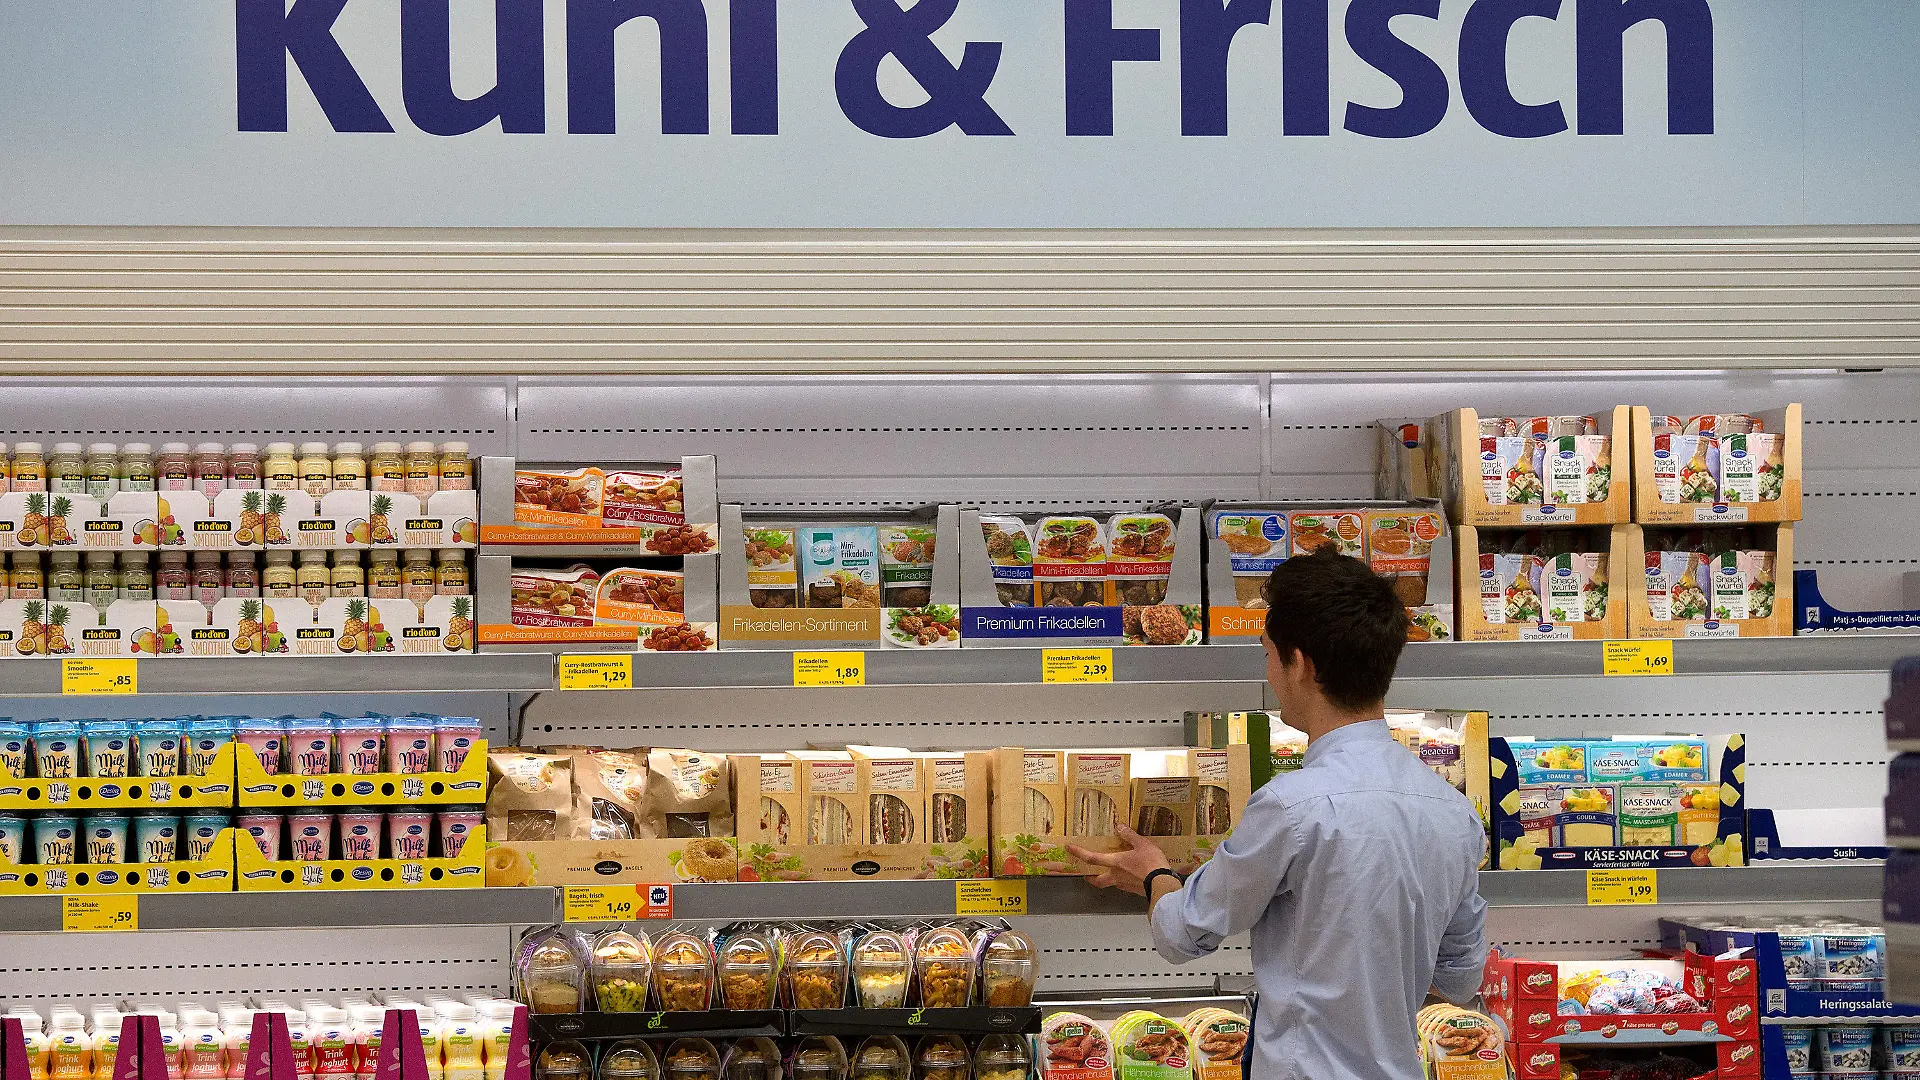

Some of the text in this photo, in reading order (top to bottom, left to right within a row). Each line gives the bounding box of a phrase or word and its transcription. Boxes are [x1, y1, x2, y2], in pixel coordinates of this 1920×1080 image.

[833, 0, 1017, 139] &
[1064, 0, 1715, 139] Frisch
[1726, 458, 1752, 466] Snack
[1525, 512, 1572, 522] Snackwürfel
[1698, 512, 1745, 521] Snackwürfel
[83, 533, 124, 547] SMOOTHIE
[193, 533, 233, 547] SMOOTHIE
[297, 532, 336, 547] SMOOTHIE
[404, 532, 443, 546] SMOOTHIE
[1114, 564, 1171, 574] Mini-Frikadelle
[1551, 575, 1578, 584] Snack
[1716, 574, 1743, 583] Snack
[733, 617, 868, 633] Frikadellen-Sortiment
[977, 615, 1105, 630] Premium Frikadellen
[81, 641, 121, 655] SMOOTHIE
[191, 641, 230, 655] SMOOTHIE
[296, 640, 336, 654] SMOOTHIE
[402, 639, 441, 653] SMOOTHIE
[1645, 656, 1668, 667] 1,69
[835, 667, 859, 679] 1,89
[1083, 665, 1107, 676] 2,39
[108, 675, 131, 687] -,85
[602, 671, 626, 683] 1,29
[41, 754, 72, 772] Milk
[95, 753, 125, 771] Milk
[147, 753, 176, 771] Milk
[299, 751, 328, 769] Milk
[349, 751, 379, 769] Milk
[400, 750, 428, 768] Milk
[1593, 758, 1640, 768] KÄSE-SNACK
[47, 783, 70, 793] Milk
[149, 781, 172, 792] Milk
[302, 780, 324, 791] Milk
[403, 778, 424, 790] Milk
[1520, 800, 1550, 810] -SNACK
[1623, 797, 1672, 807] KÄSE-SNACK
[1584, 849, 1660, 861] KÄSE-SNACK
[1833, 848, 1857, 858] Sushi
[46, 867, 68, 879] Milk
[147, 866, 169, 878] Milk
[301, 865, 323, 876] Milk
[402, 863, 423, 875] Milk
[1628, 885, 1652, 898] 1,99
[999, 895, 1021, 908] 1,59
[606, 902, 631, 914] 1,49
[108, 911, 132, 924] -,59
[1819, 998, 1893, 1012] Heringssalate
[1622, 1019, 1627, 1029] 7
[198, 1053, 218, 1063] Trink
[325, 1048, 345, 1058] Trink
[59, 1055, 79, 1064] Trink
[320, 1058, 350, 1071] Joghurt
[192, 1062, 222, 1075] Joghurt
